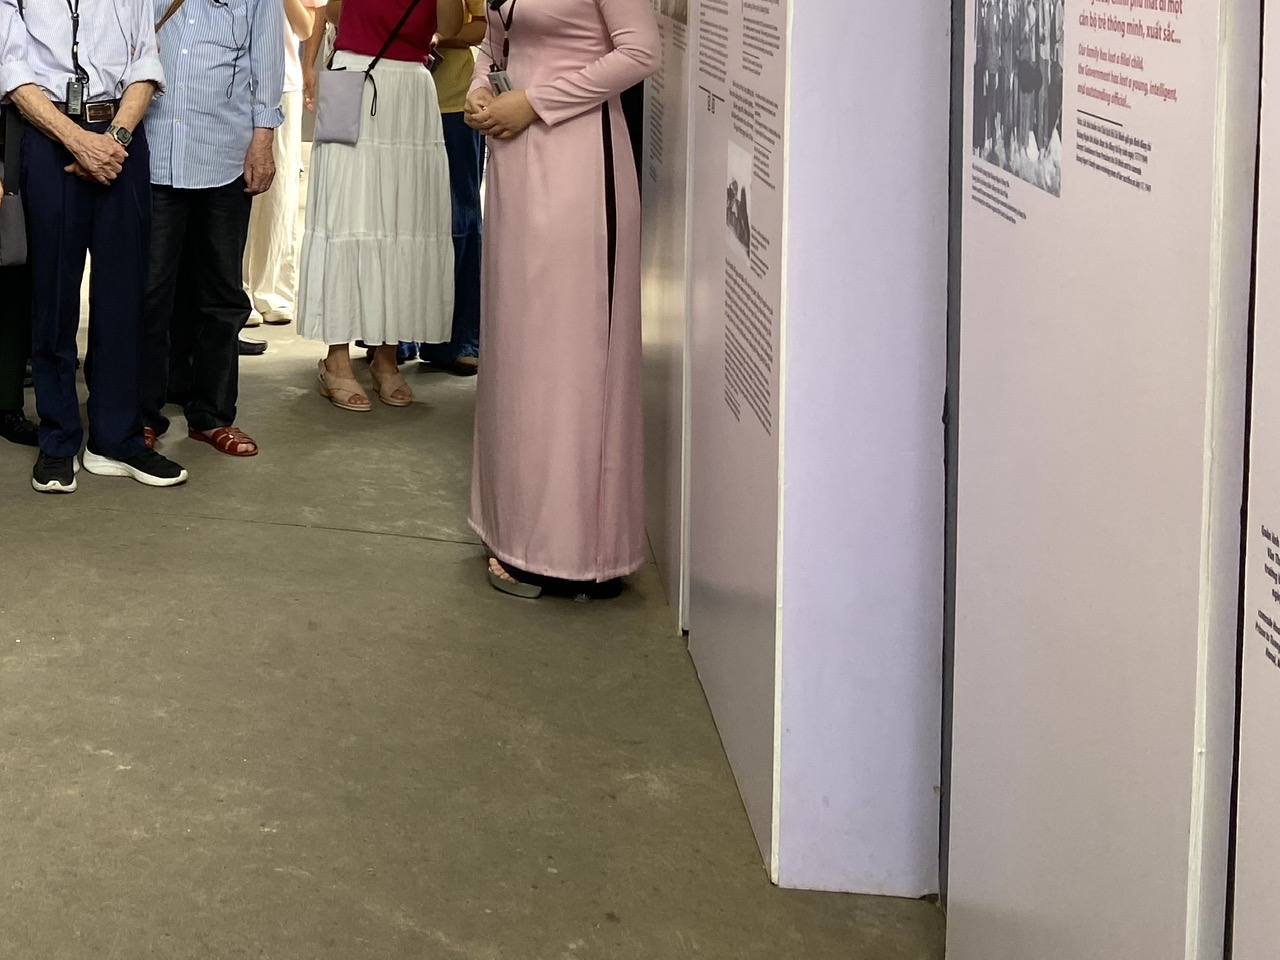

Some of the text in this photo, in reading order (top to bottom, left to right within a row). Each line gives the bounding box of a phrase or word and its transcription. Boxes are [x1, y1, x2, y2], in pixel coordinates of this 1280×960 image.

[1079, 9, 1181, 44] cán bộ trẻ thông minh, xuất sắc...
